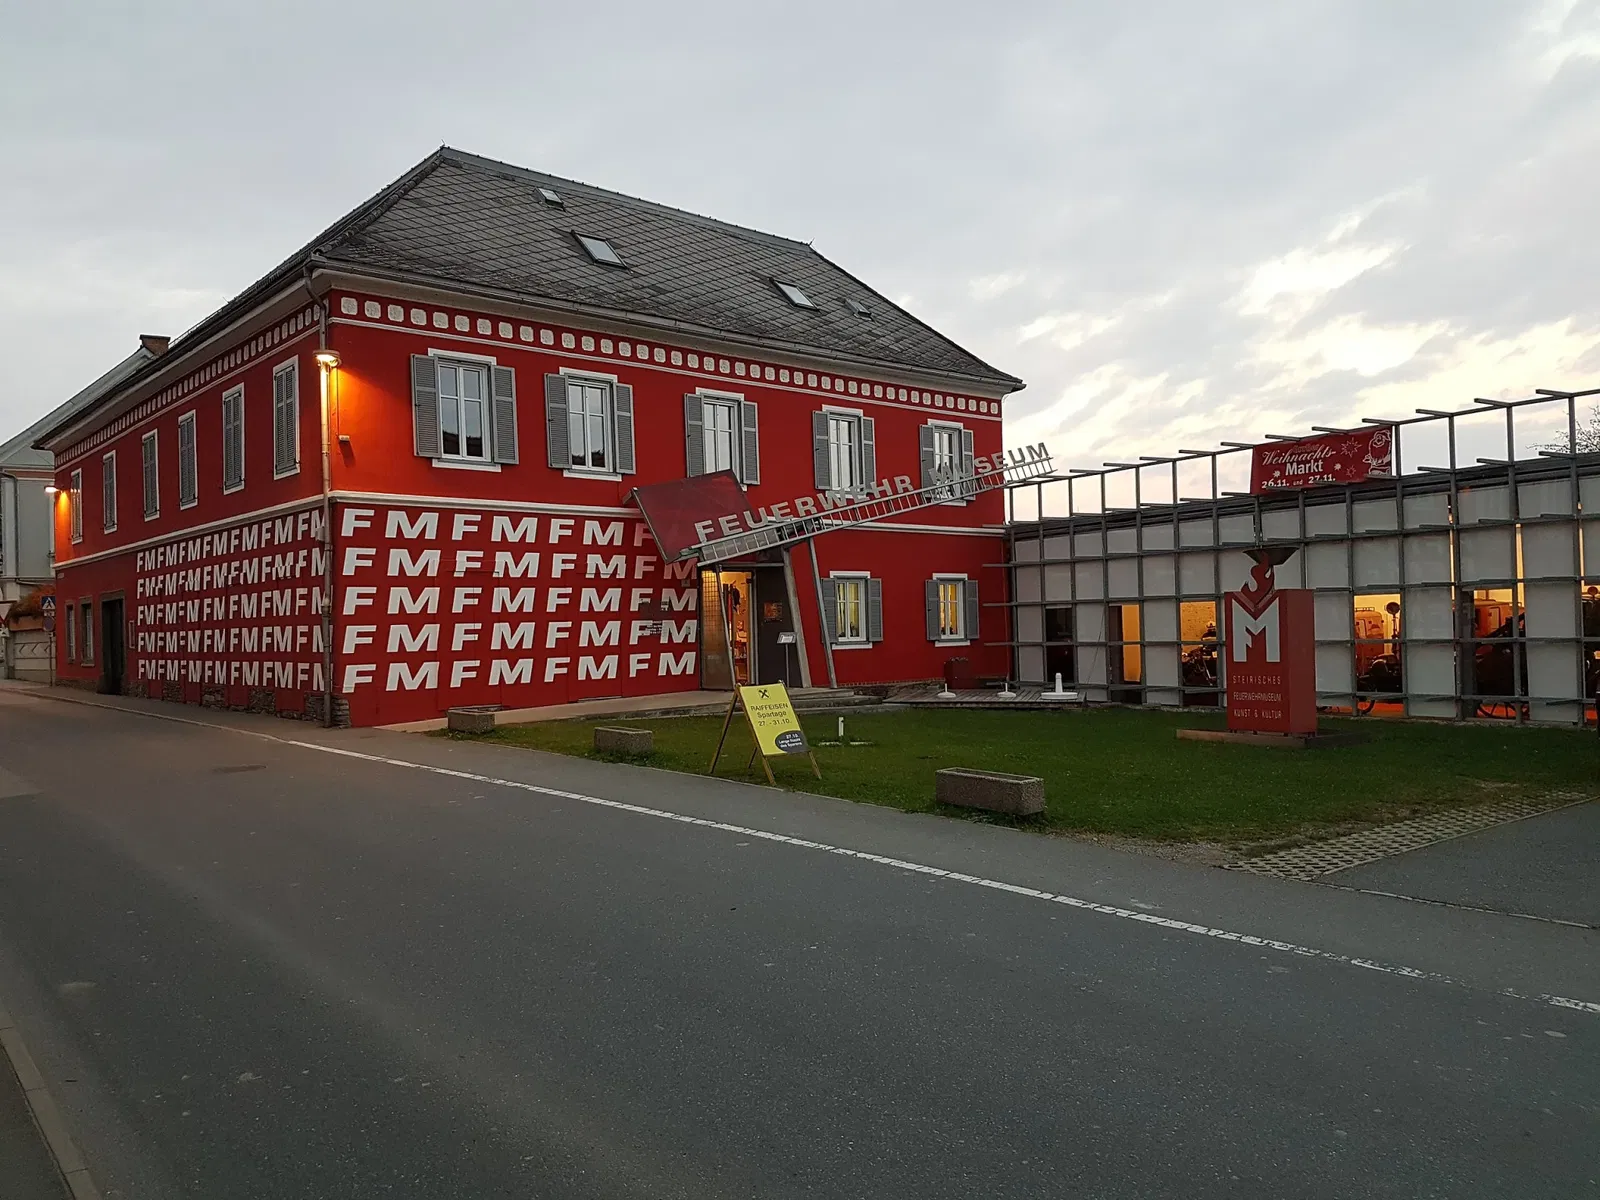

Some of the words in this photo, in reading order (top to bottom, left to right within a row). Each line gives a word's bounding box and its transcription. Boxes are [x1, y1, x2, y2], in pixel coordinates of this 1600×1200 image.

[1262, 444, 1336, 465] Weihnachts-
[1285, 459, 1324, 476] Markt
[1261, 478, 1289, 489] 26.11.
[694, 475, 914, 544] FEUERWEHR
[928, 441, 1050, 482] MUSEUM
[1233, 675, 1281, 685] STEIRISCHES
[1233, 691, 1282, 702] FEUERWEHRMUSEUM
[750, 703, 789, 711] RAIFFEISEN
[757, 711, 787, 719] Spartage
[1234, 708, 1251, 717] KUNST
[1261, 709, 1282, 719] KULTUR
